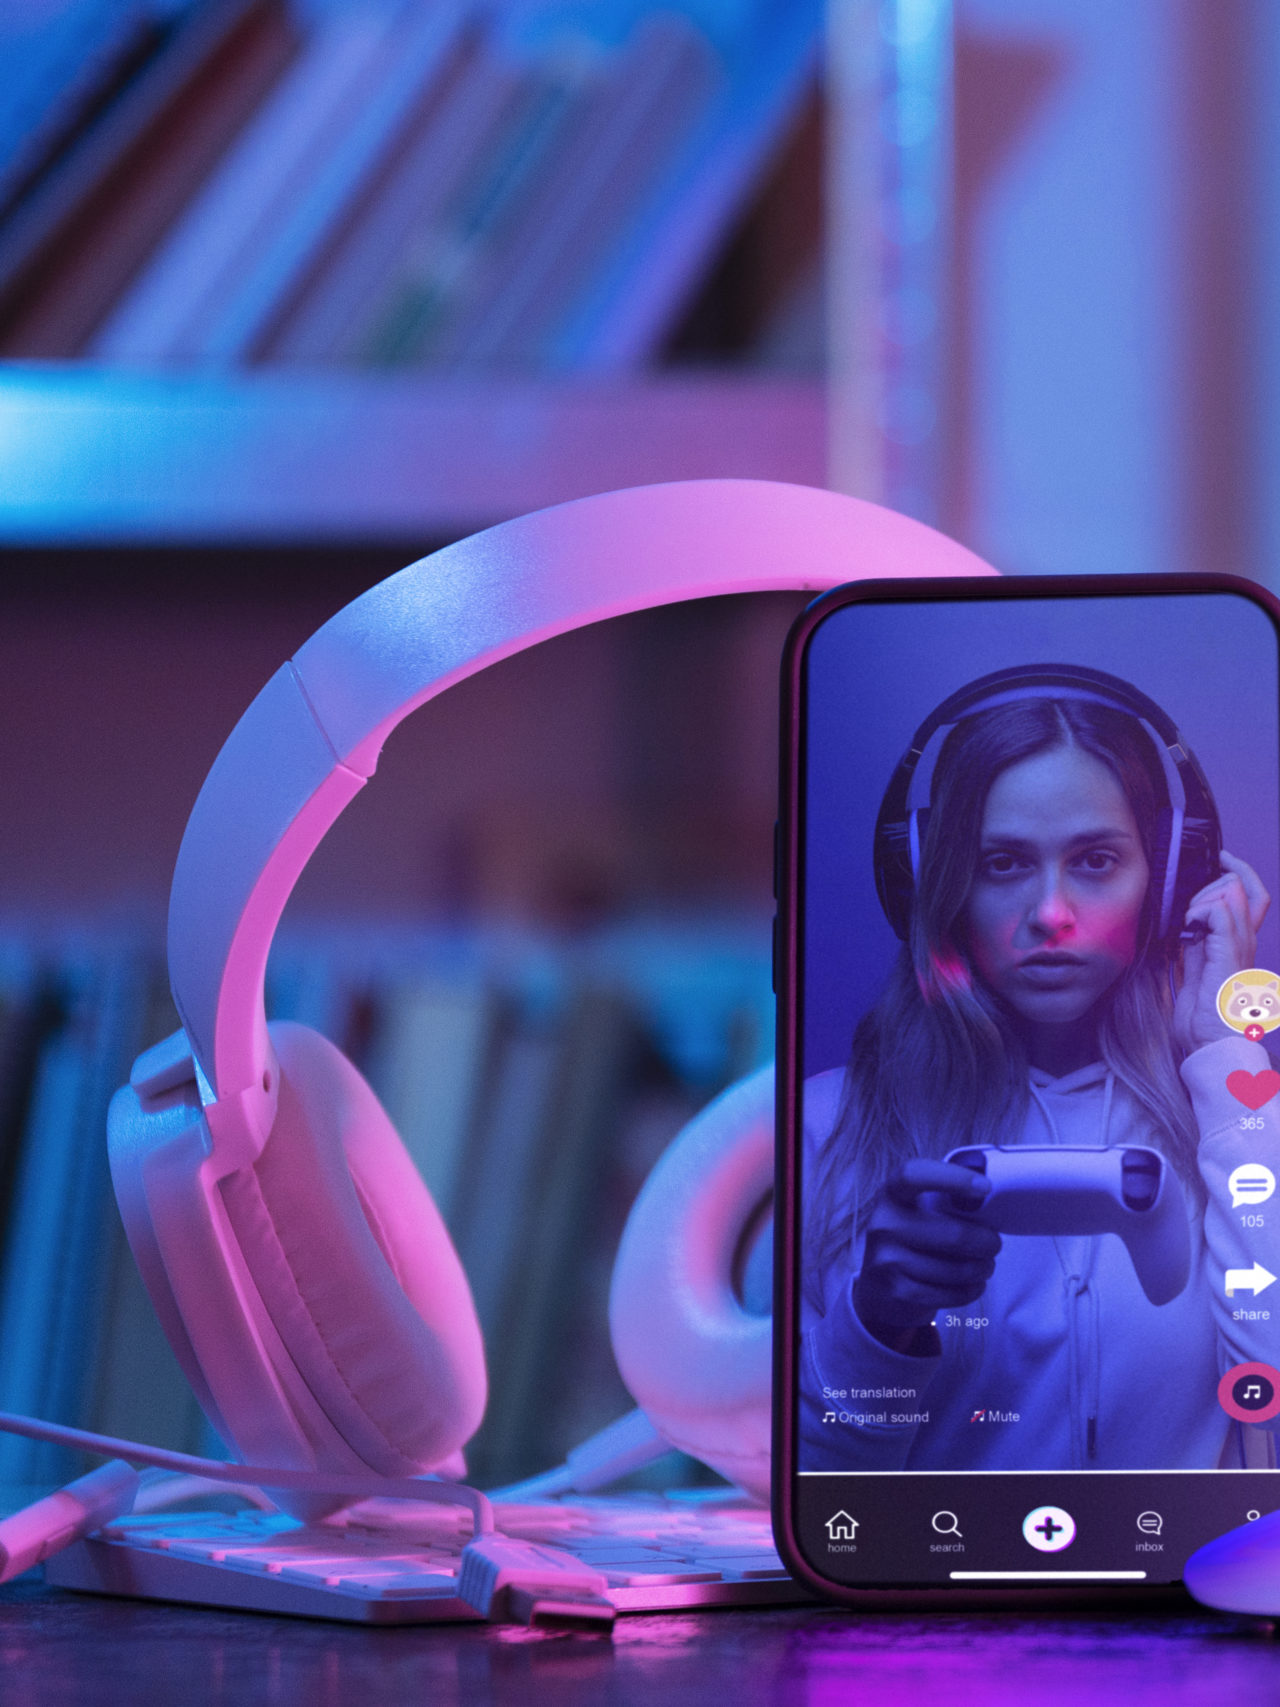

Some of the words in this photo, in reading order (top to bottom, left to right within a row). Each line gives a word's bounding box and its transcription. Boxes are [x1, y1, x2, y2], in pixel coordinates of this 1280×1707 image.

[1239, 1117, 1265, 1130] 365
[1240, 1215, 1265, 1228] 105
[1232, 1308, 1270, 1321] share
[945, 1315, 961, 1327] 3h
[965, 1317, 989, 1330] ago
[823, 1387, 847, 1399] See
[851, 1386, 916, 1399] translation
[838, 1411, 887, 1426] Original
[891, 1411, 930, 1423] sound
[988, 1411, 1020, 1423] Mute
[827, 1542, 857, 1553] home
[929, 1541, 965, 1553] search
[1135, 1541, 1164, 1552] inbox
